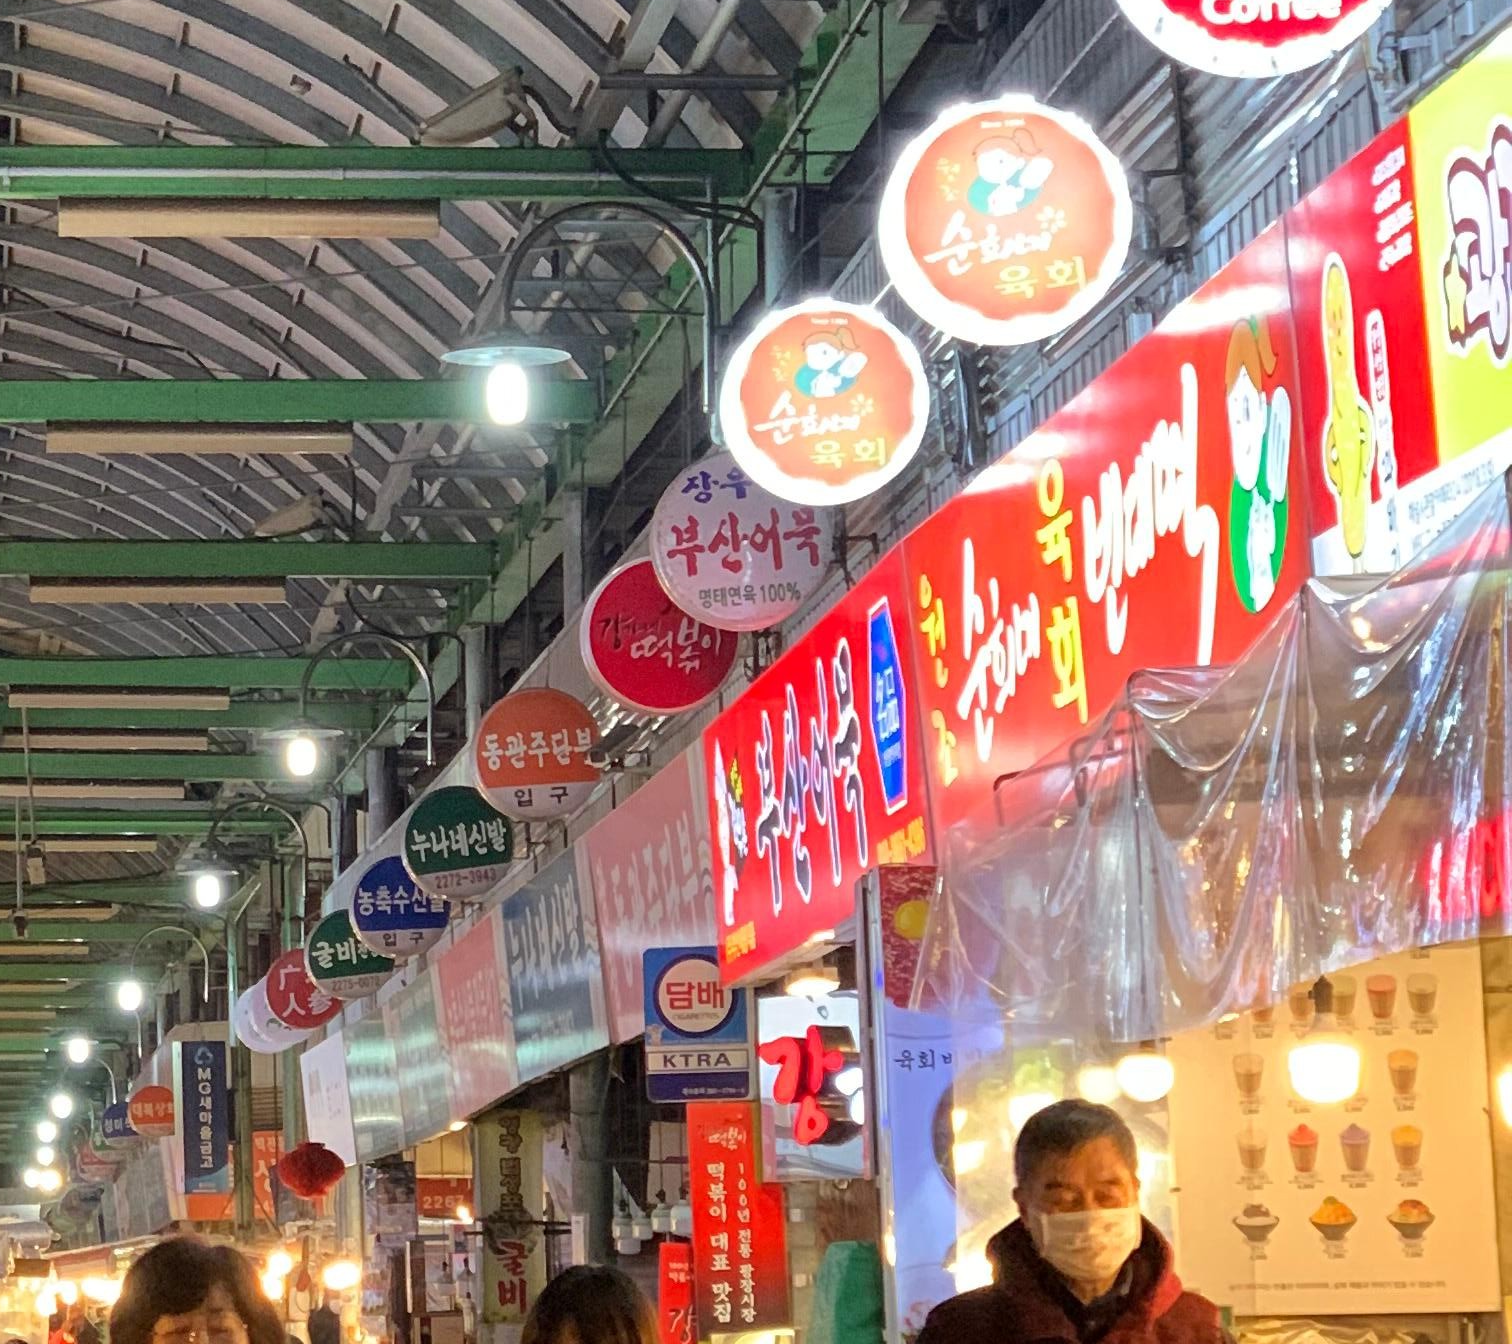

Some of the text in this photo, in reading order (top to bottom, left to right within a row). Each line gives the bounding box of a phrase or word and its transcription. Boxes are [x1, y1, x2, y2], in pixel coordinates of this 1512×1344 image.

[994, 256, 1089, 300] 육회
[809, 437, 886, 469] 육회
[667, 508, 822, 577] 부산어묵
[699, 582, 802, 609] 명태연육 100%
[919, 573, 959, 787] 원조
[956, 537, 1042, 763] 순희네
[1036, 457, 1089, 724] 육회
[1082, 362, 1221, 666] 빈대떡
[631, 615, 723, 675] 떡볶이
[515, 787, 569, 807] 입구
[755, 636, 869, 917] 부산어묵
[410, 817, 507, 863] 누나네신발
[383, 932, 425, 946] 입구
[666, 981, 725, 1010] 담배
[663, 1053, 732, 1068] KTRA
[758, 1024, 844, 1146] 강
[706, 1162, 733, 1324] 떡볶이 대표 맛집
[737, 1162, 757, 1324] 100년 전통 광장시장
[497, 1240, 529, 1315] 굴비
